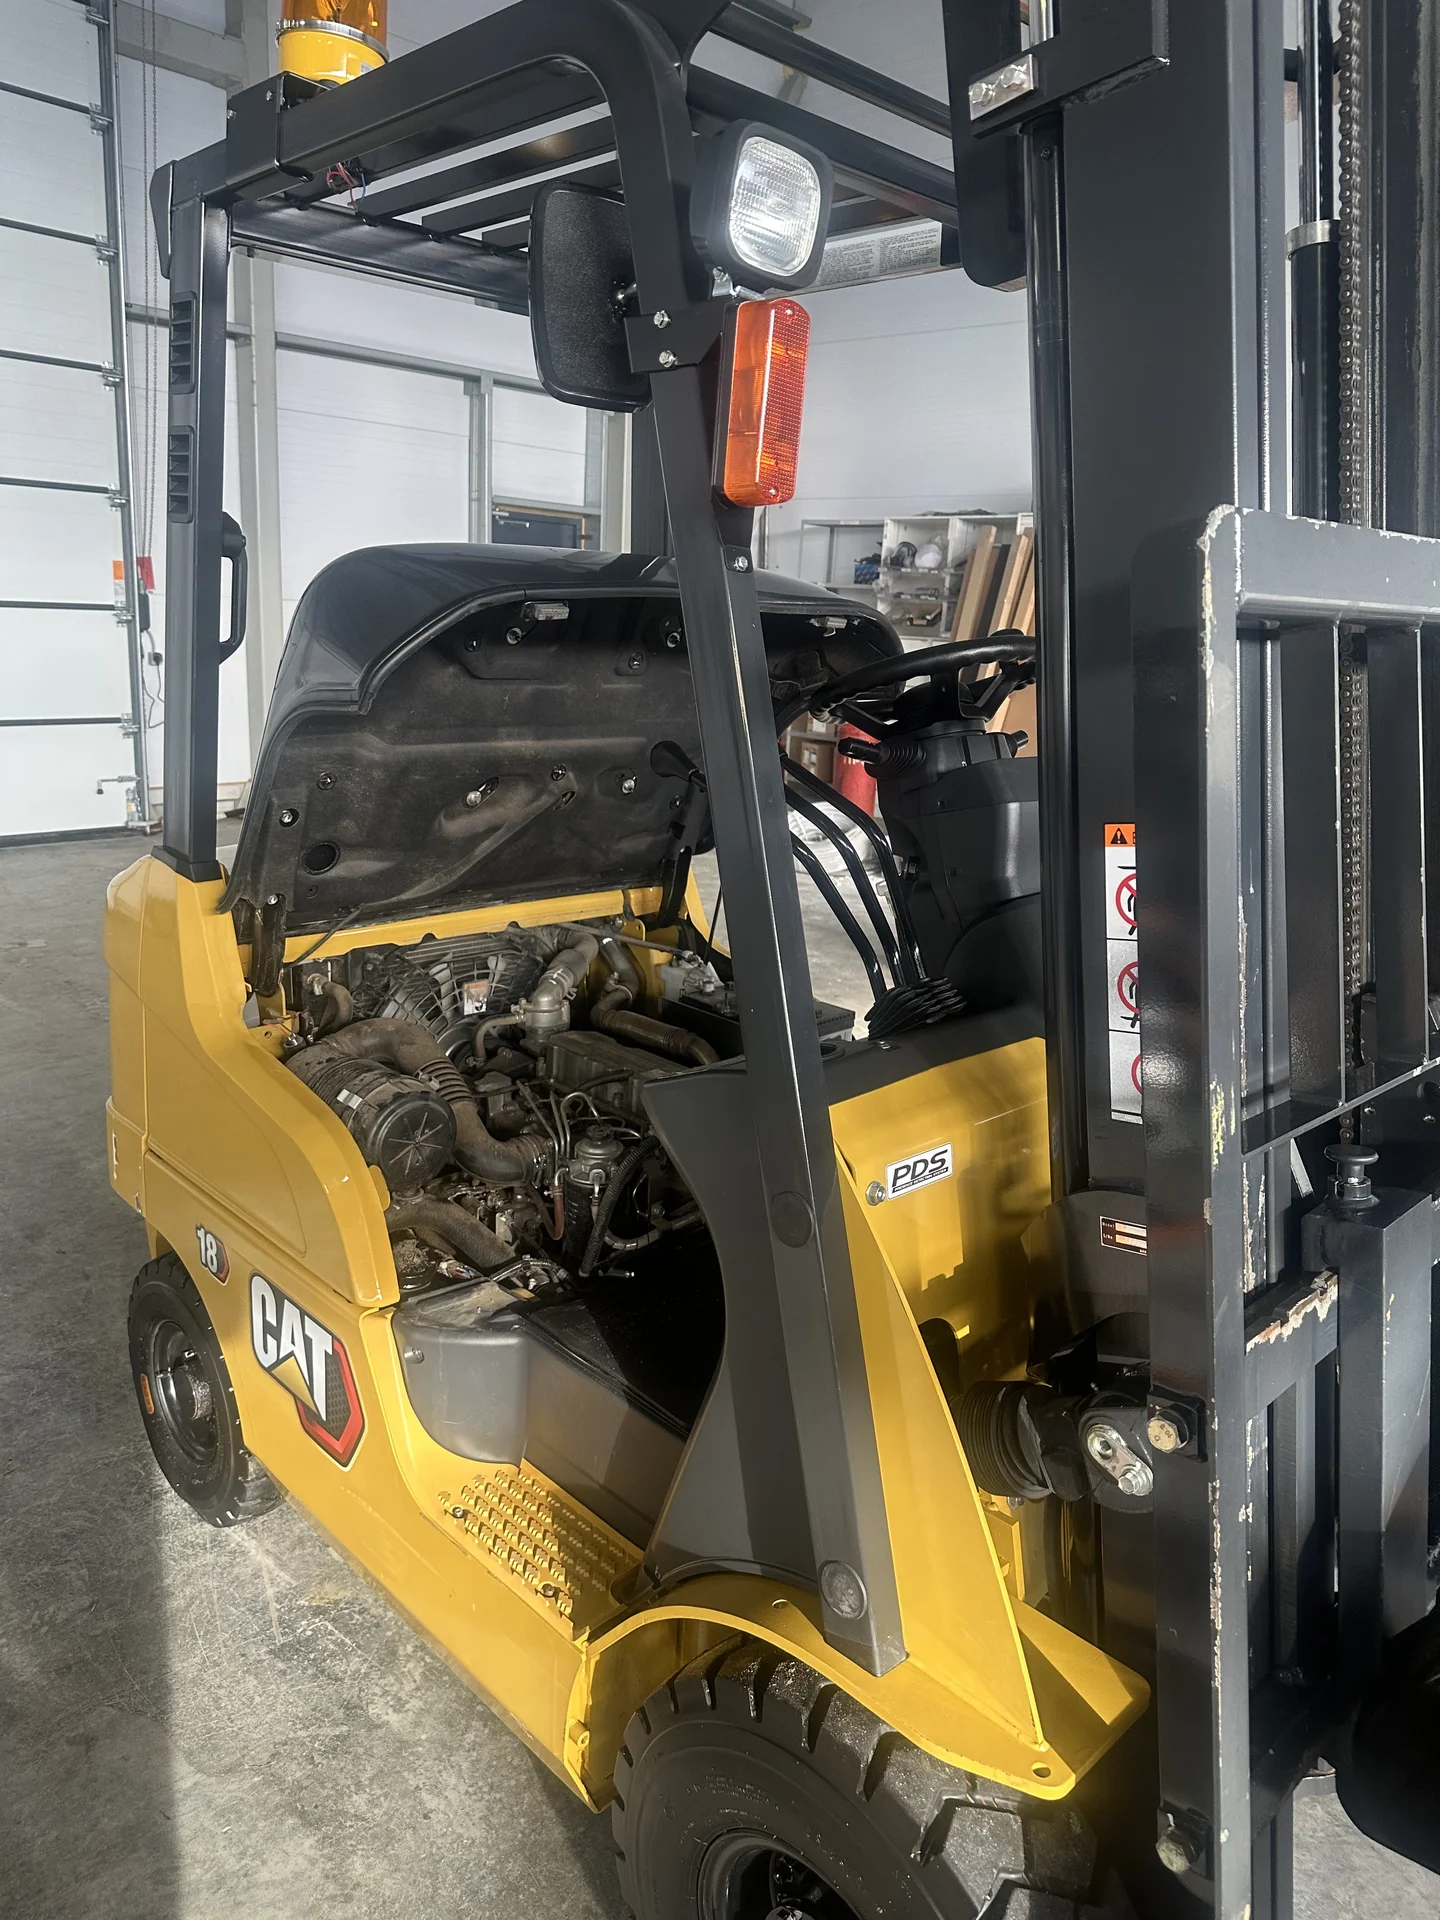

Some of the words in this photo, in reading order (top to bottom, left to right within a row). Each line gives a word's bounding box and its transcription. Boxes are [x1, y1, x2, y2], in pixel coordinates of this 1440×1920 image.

[892, 1148, 948, 1188] PDS
[197, 1226, 219, 1274] 18
[251, 1275, 333, 1422] CAT
